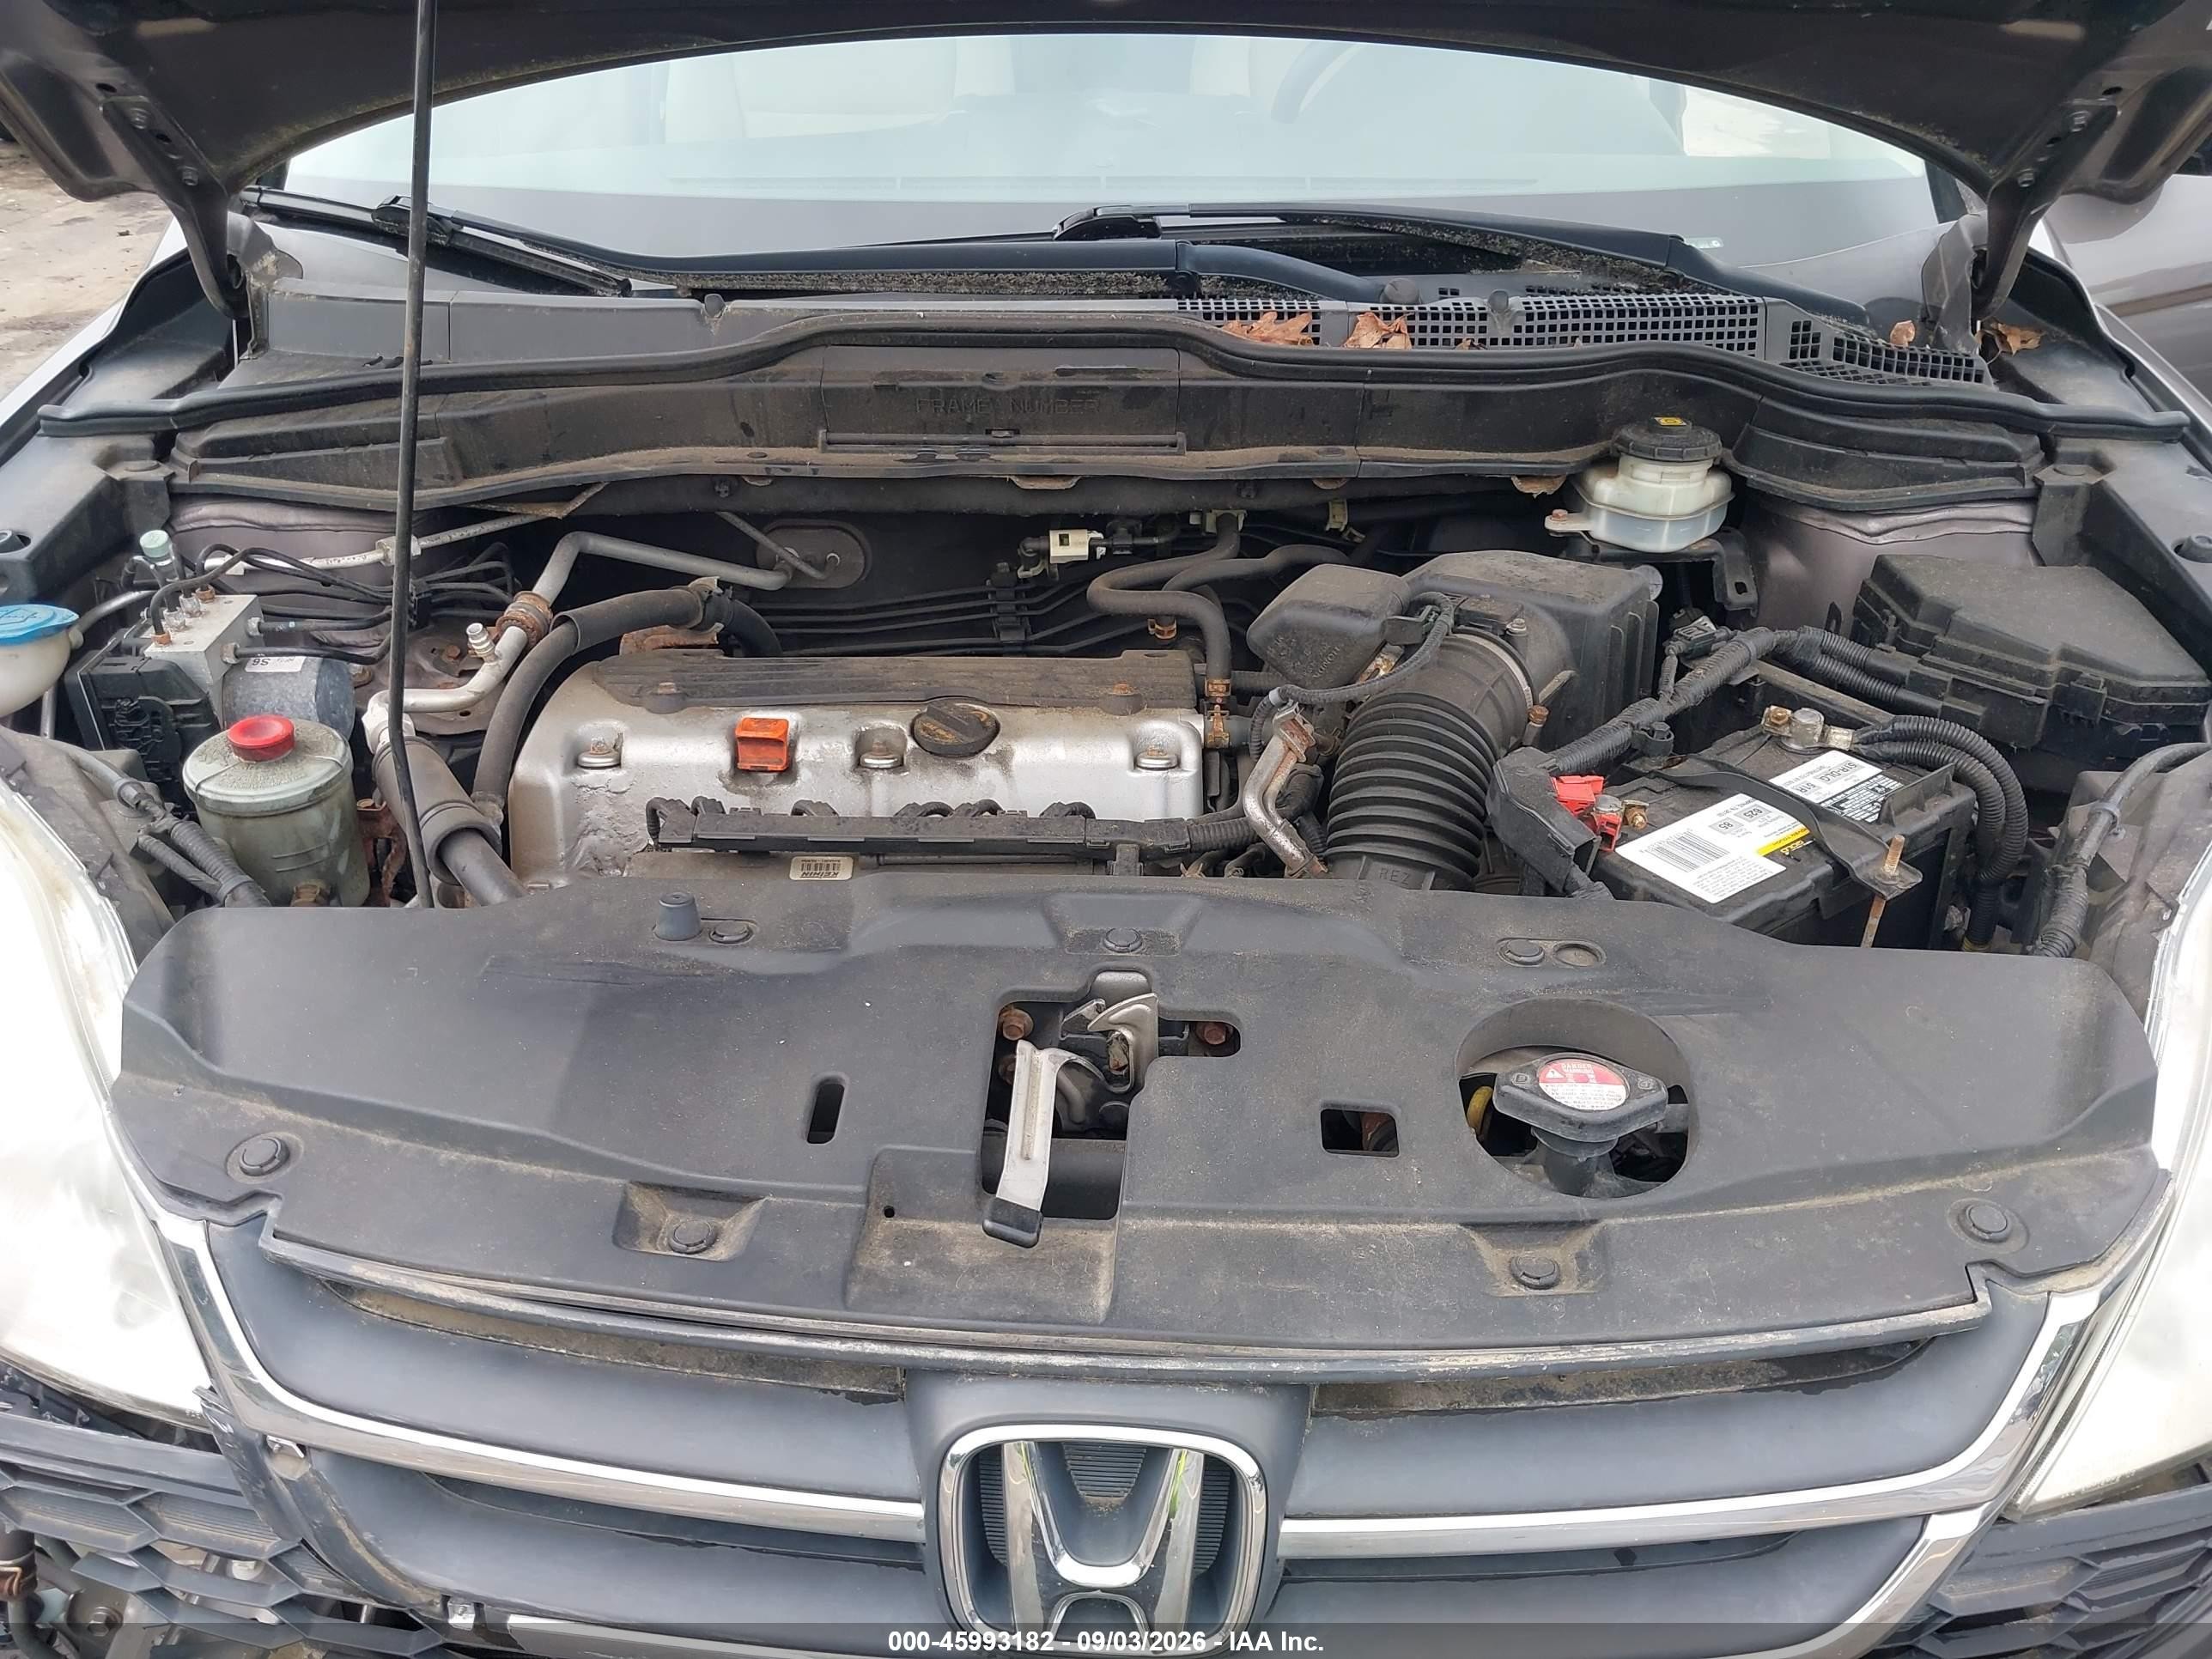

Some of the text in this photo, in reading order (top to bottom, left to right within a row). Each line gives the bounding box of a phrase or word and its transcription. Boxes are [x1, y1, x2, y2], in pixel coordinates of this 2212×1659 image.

[915, 397, 1101, 414] FRAME NUMBER
[1820, 762, 1857, 781] 51R-DLG
[1743, 808, 1763, 818] 625
